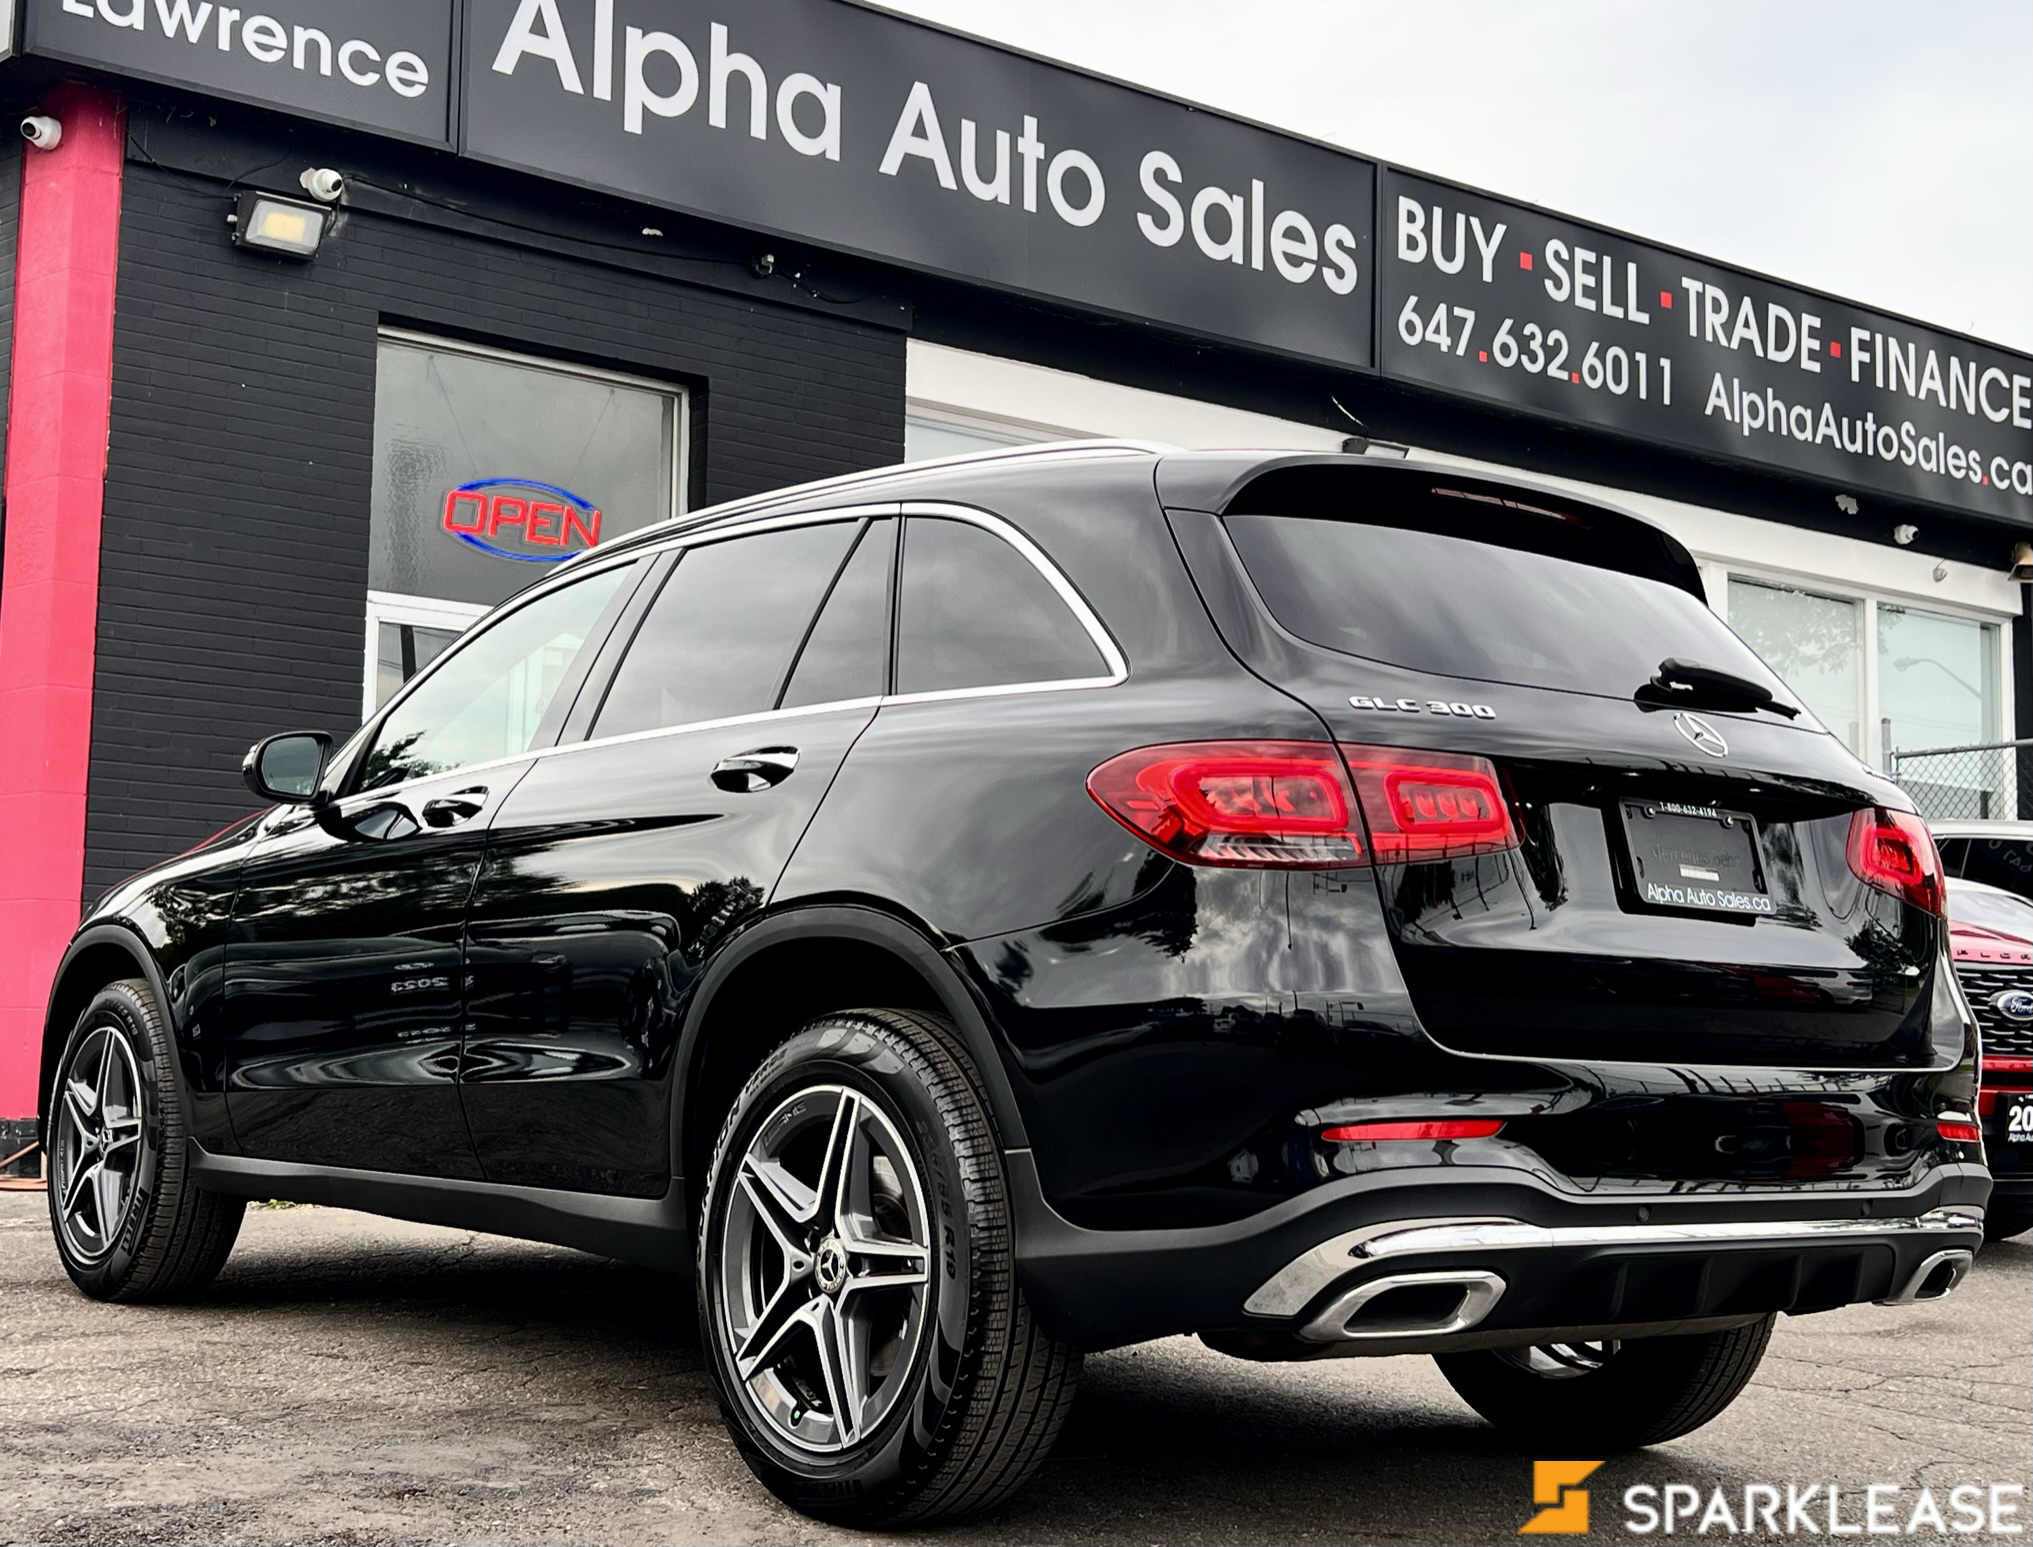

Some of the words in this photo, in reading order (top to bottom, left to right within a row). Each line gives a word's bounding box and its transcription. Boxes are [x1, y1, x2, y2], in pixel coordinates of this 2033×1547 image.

[63, 0, 428, 98] awrence
[492, 0, 841, 162] Alpha
[879, 81, 1105, 227] Auto
[1137, 150, 1358, 295] Sales
[1397, 195, 1507, 283] BUY
[1544, 238, 1650, 325] SELL
[1681, 276, 1821, 373] TRADE
[1850, 326, 2032, 430] FINANCE
[1398, 295, 1672, 406] 647.632.6011
[1704, 372, 2033, 496] AlphaAutoSales.ca
[443, 490, 601, 547] OPEN
[1349, 696, 1420, 713] GLC
[1426, 700, 1496, 720] 300
[1647, 882, 1684, 904] Alpha
[1686, 887, 1717, 906] Auto
[1717, 889, 1772, 911] Sales.ca
